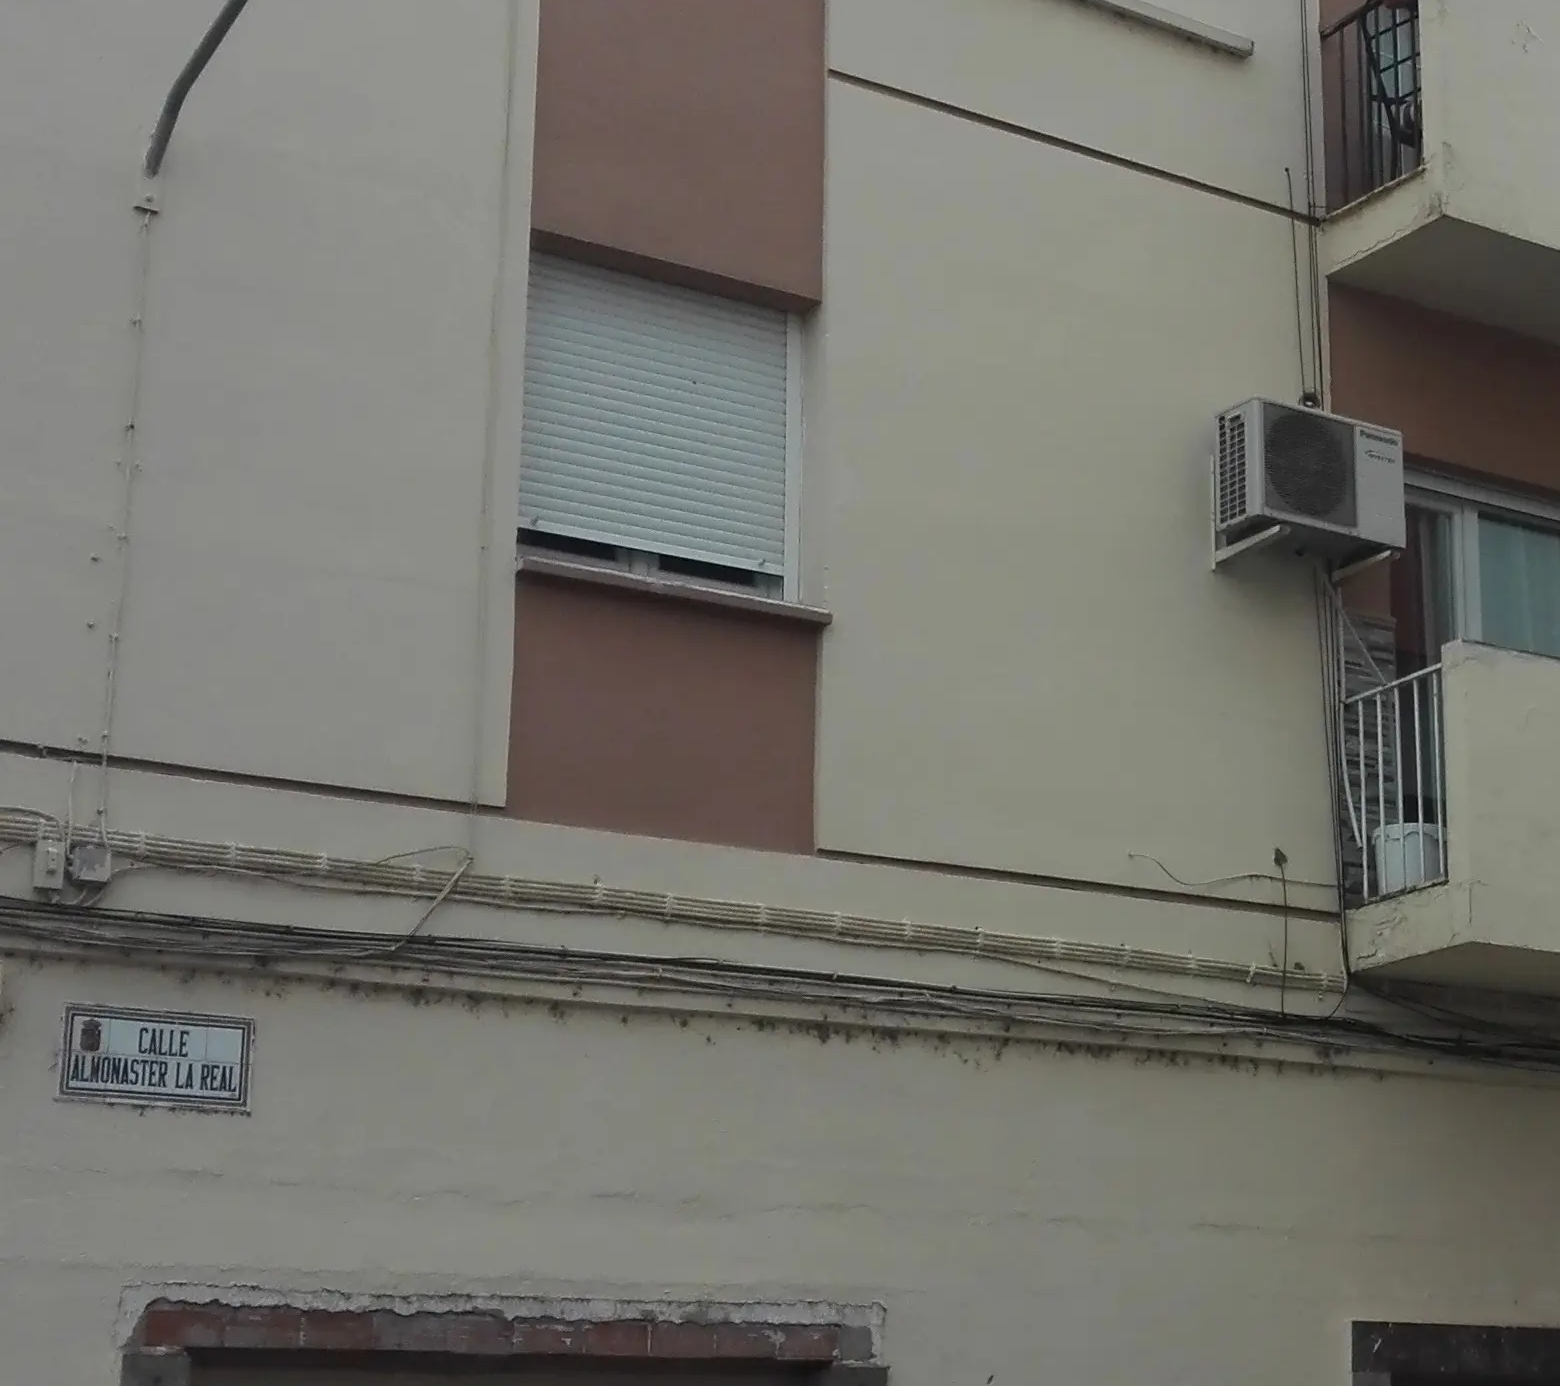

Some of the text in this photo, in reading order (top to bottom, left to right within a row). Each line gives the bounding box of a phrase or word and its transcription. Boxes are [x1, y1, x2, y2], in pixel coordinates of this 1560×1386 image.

[138, 1027, 190, 1058] CALLE
[70, 1054, 237, 1093] ALMONASTER LA REAL
